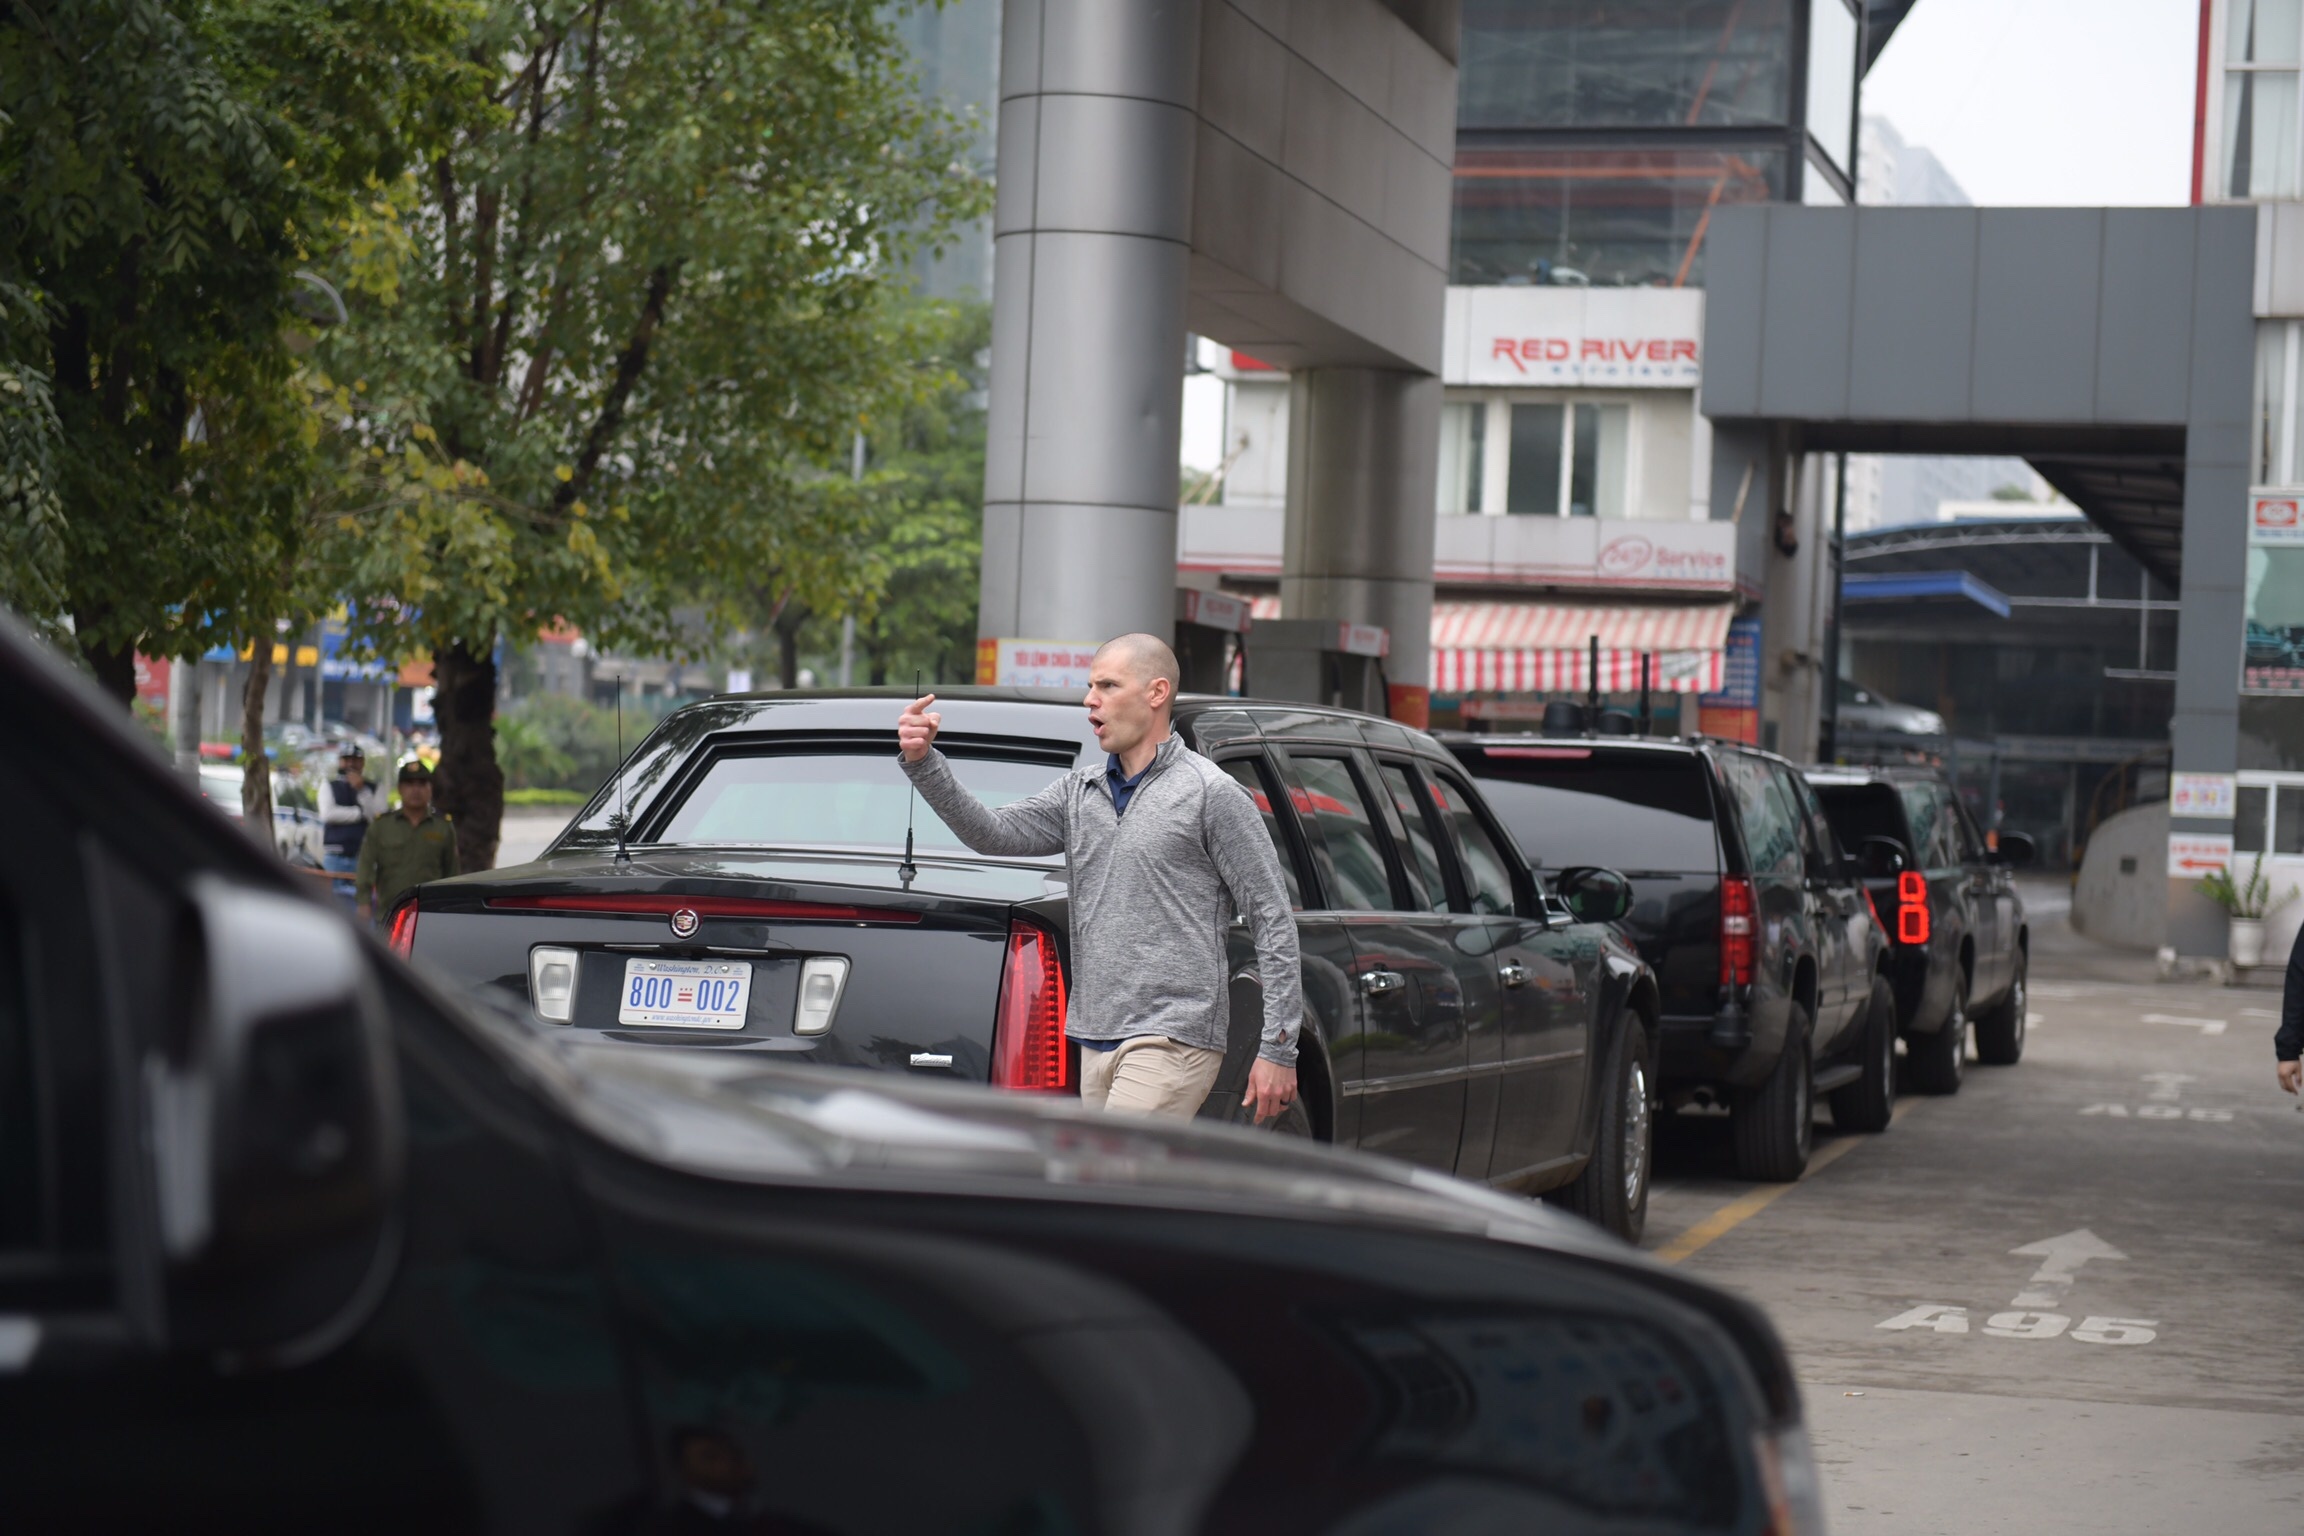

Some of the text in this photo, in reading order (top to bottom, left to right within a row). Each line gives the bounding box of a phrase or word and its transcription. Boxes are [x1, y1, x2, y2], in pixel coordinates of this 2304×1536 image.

[1492, 338, 1697, 373] RED RIVER
[1655, 547, 1726, 569] Service
[629, 976, 740, 1012] 800 002
[1874, 1304, 2160, 1345] A95
